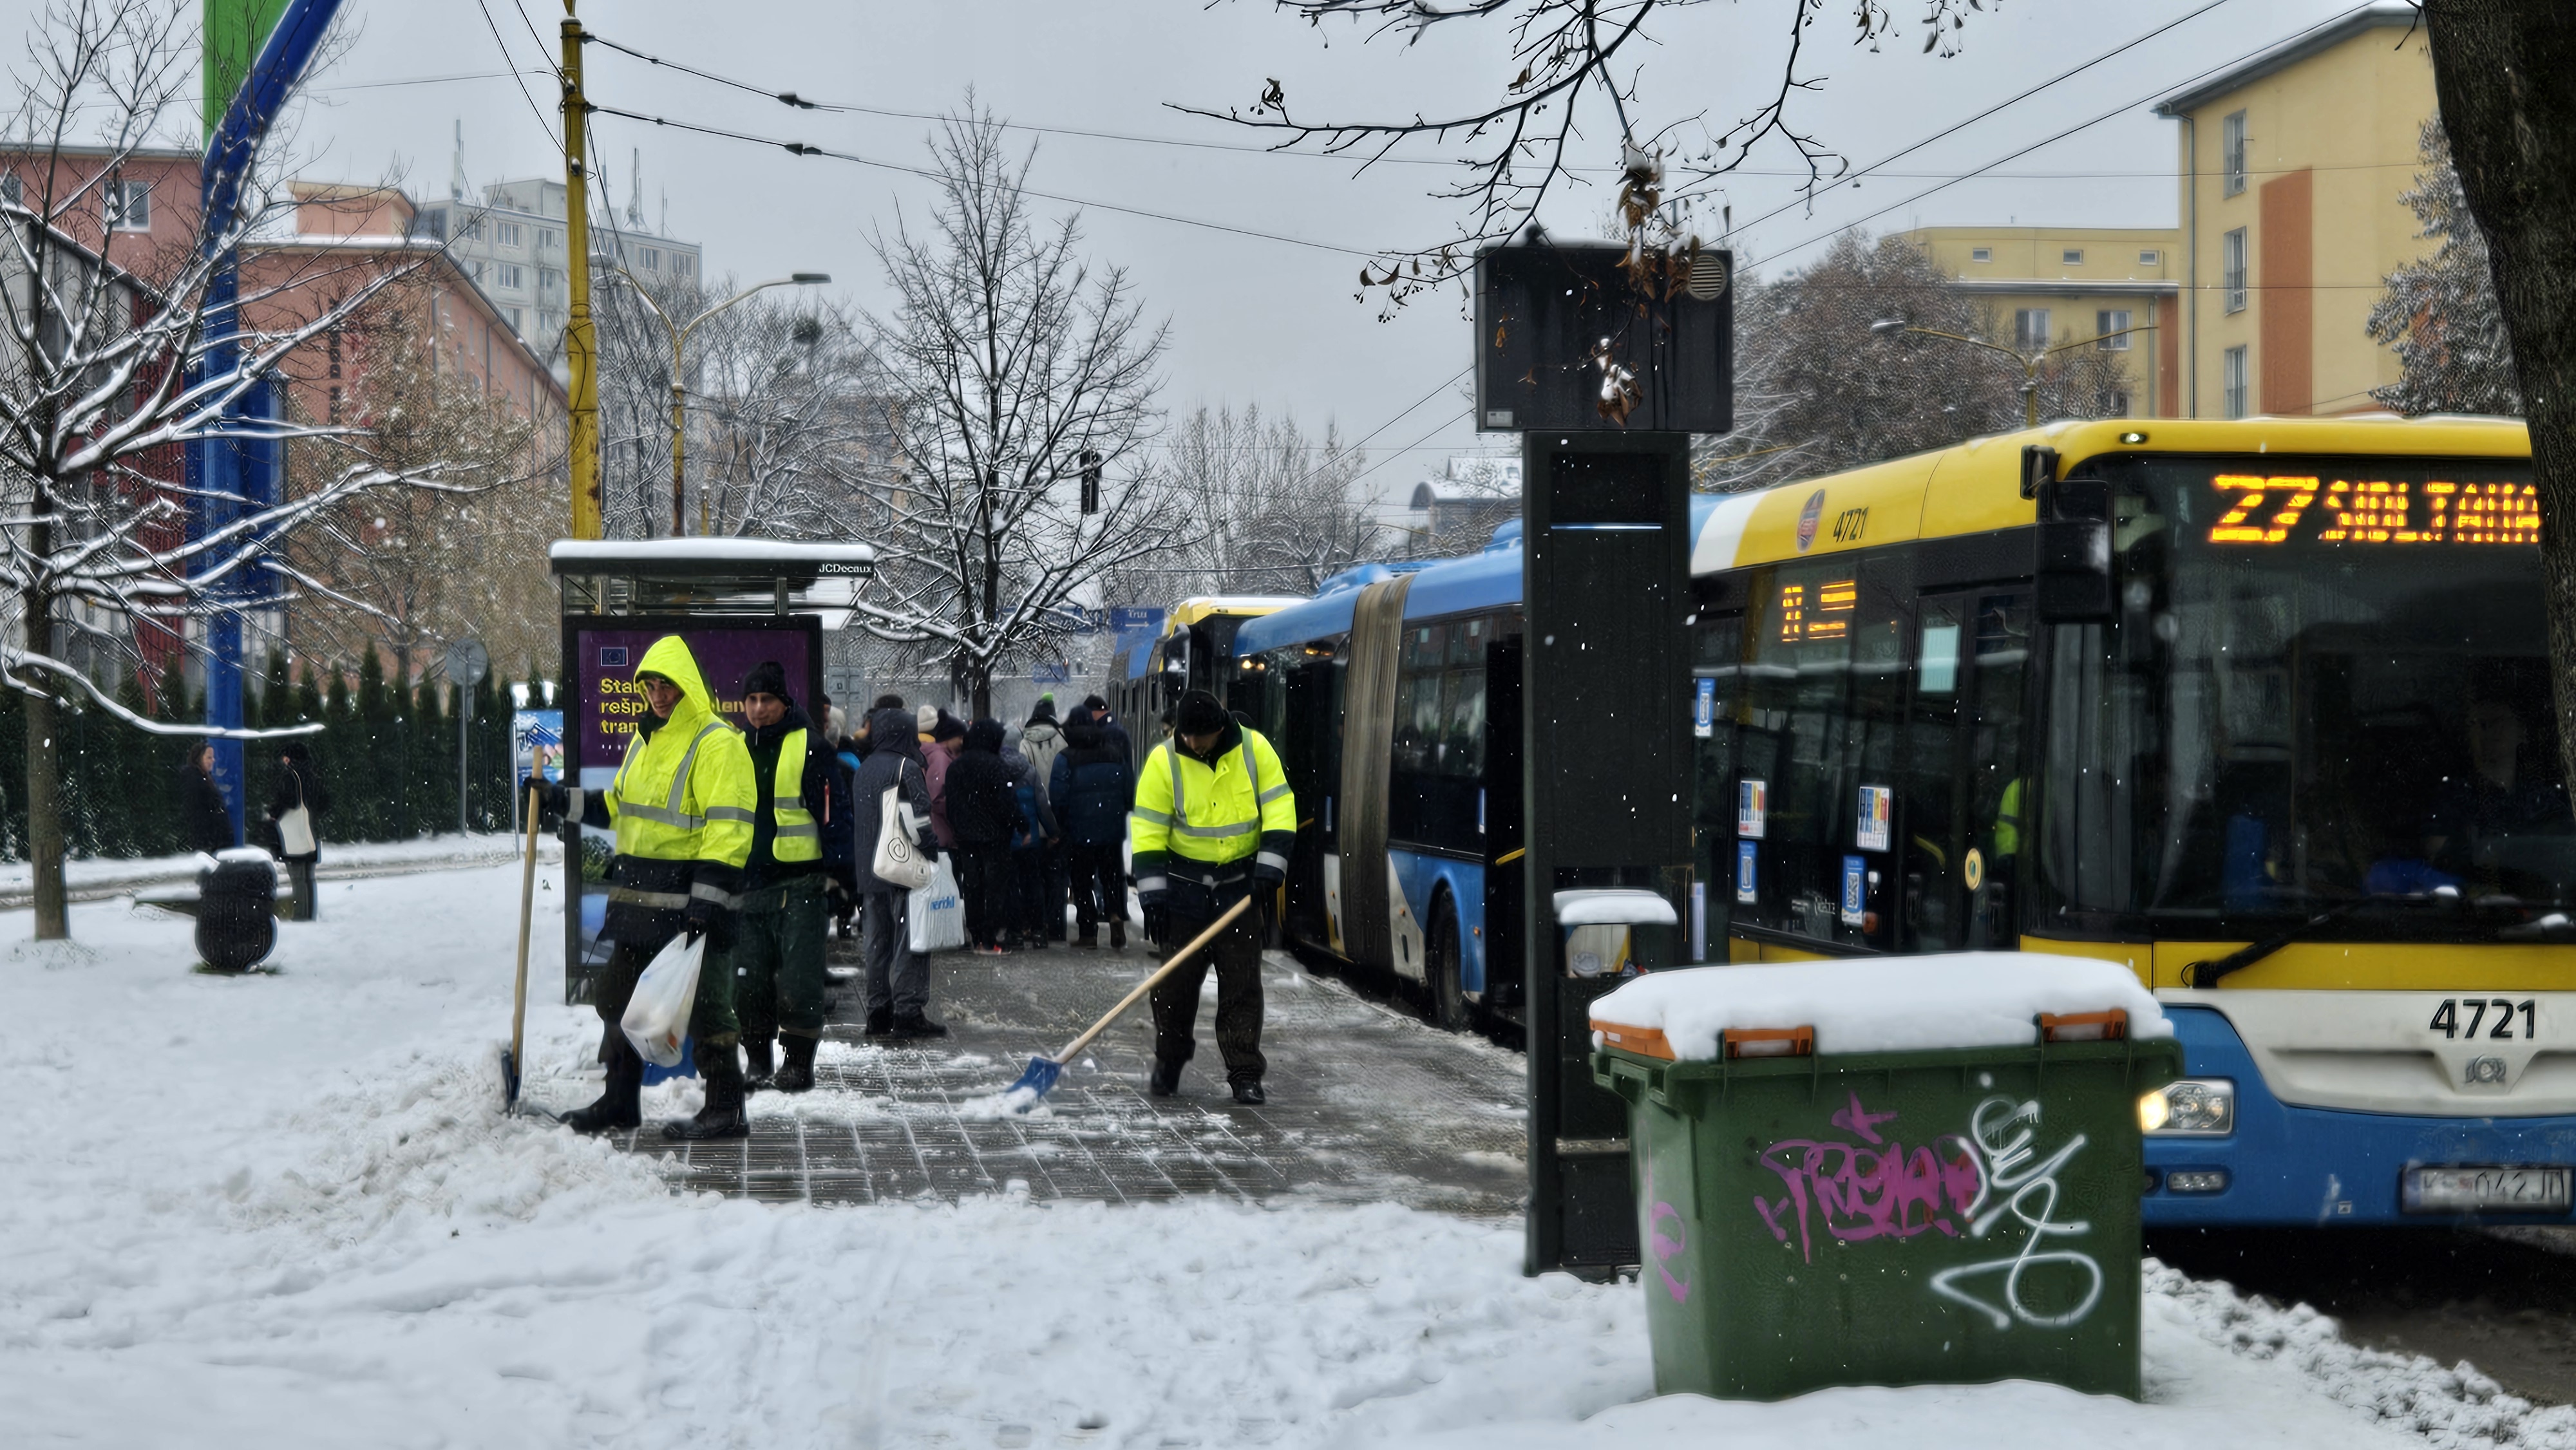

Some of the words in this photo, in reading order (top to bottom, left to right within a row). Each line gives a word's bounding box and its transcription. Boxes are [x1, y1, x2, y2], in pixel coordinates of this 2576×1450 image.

[1833, 506, 1869, 543] 4721
[2213, 476, 2318, 541] 27
[819, 563, 873, 573] JCDecaux
[2429, 999, 2535, 1039] 4721
